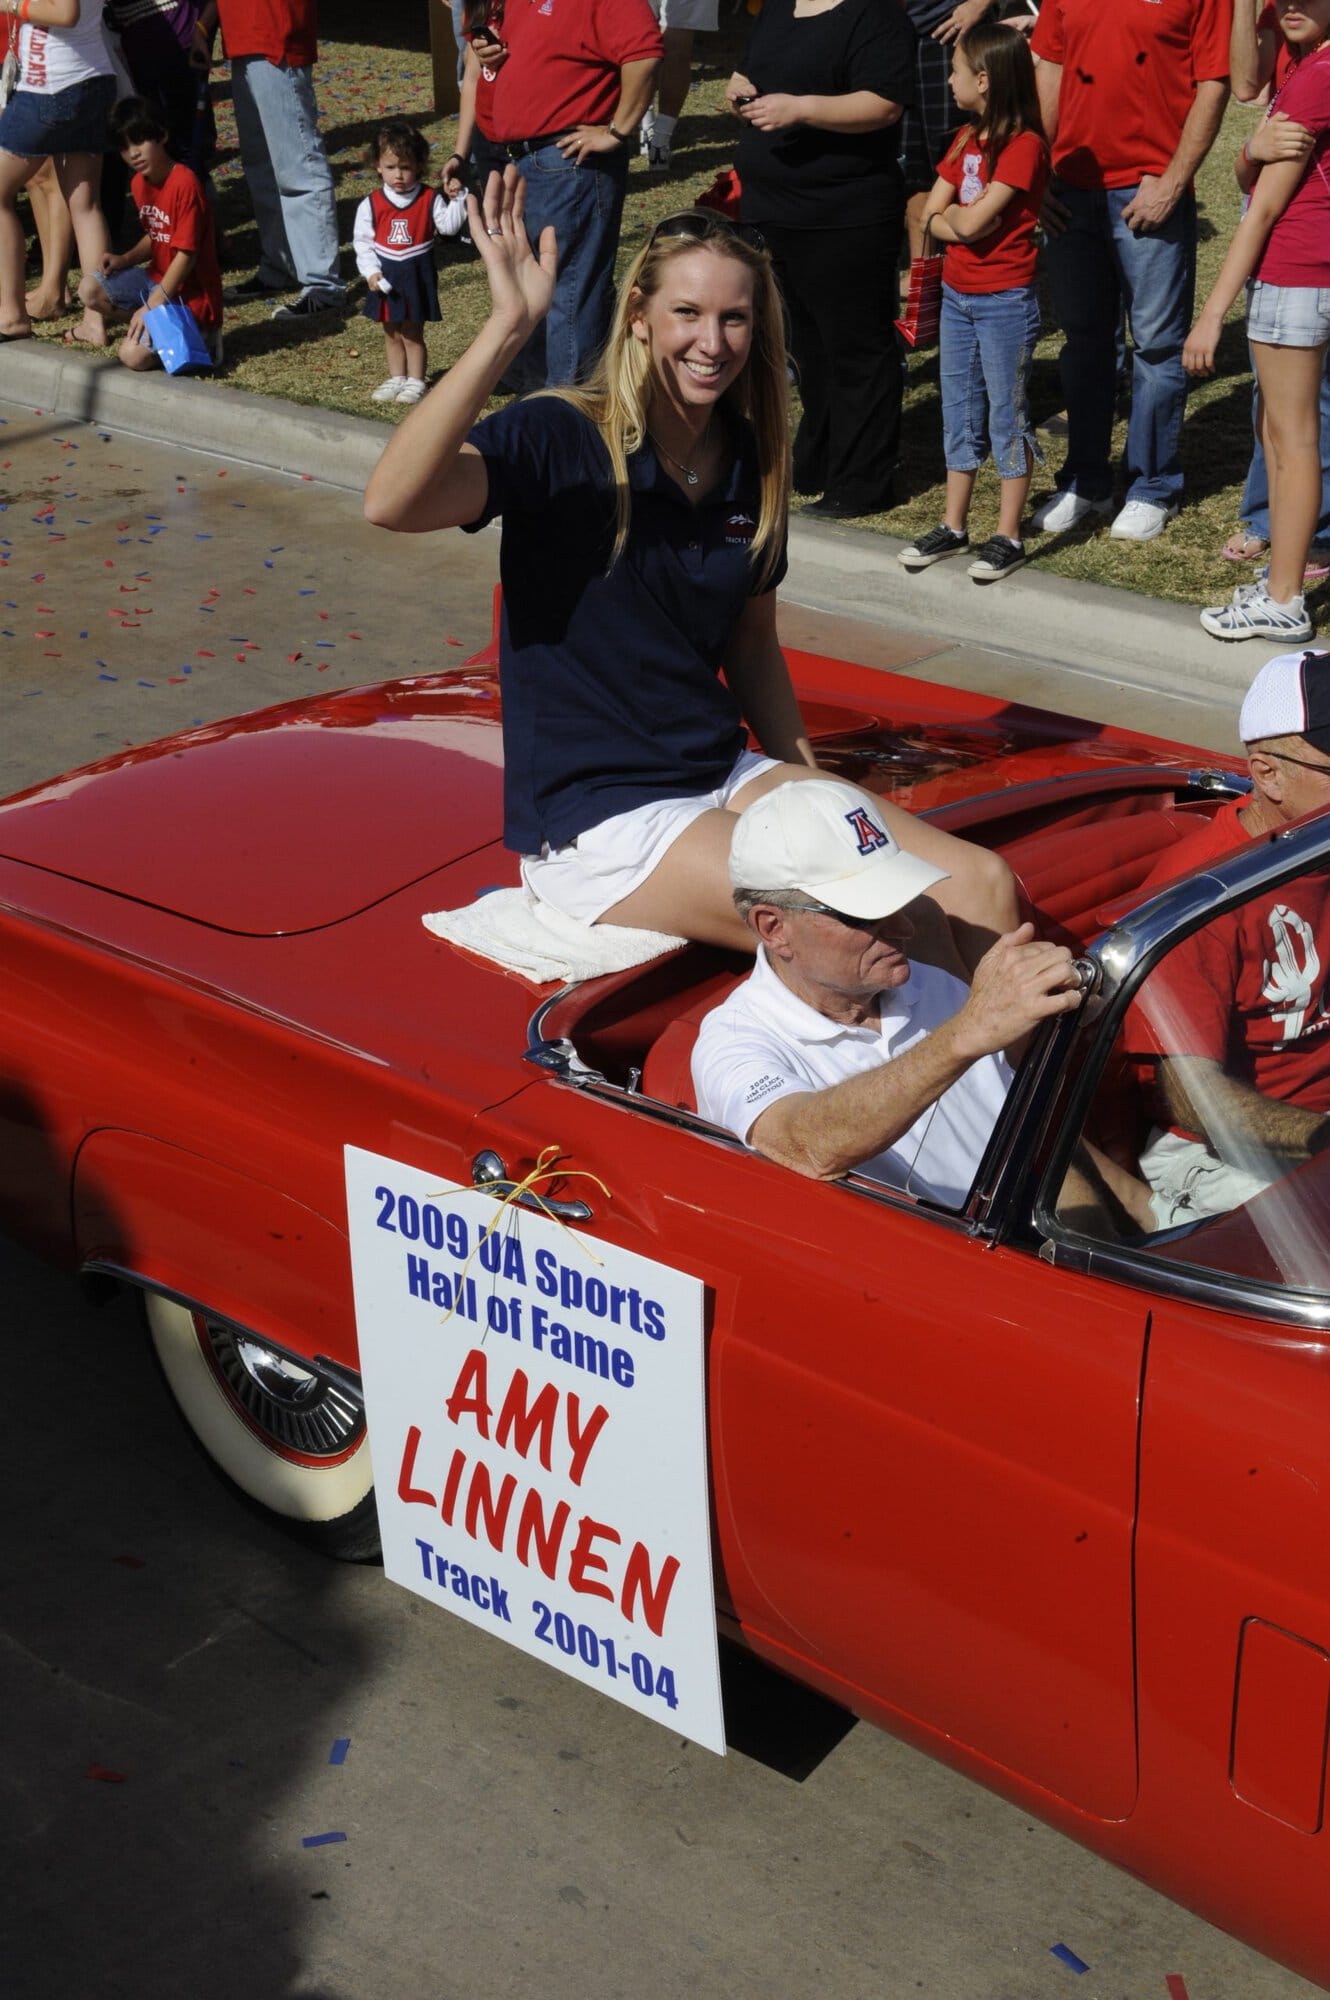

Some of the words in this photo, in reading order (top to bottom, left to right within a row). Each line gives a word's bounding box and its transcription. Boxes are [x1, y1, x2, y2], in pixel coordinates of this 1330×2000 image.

[387, 219, 413, 245] A
[725, 536, 742, 544] TRACK
[844, 806, 890, 857] A
[745, 1089, 759, 1100] JIM
[759, 1076, 781, 1090] CLICK
[750, 1075, 769, 1090] 2009
[375, 1186, 468, 1260] 2009
[478, 1223, 527, 1286] UA
[535, 1249, 666, 1341] Sports
[406, 1253, 478, 1322] Hall
[487, 1295, 522, 1341] of
[531, 1305, 635, 1388] Fame
[445, 1349, 610, 1487] AMY
[397, 1425, 681, 1638] LINNEN
[415, 1538, 512, 1623] Track
[532, 1600, 679, 1710] 2001-04
